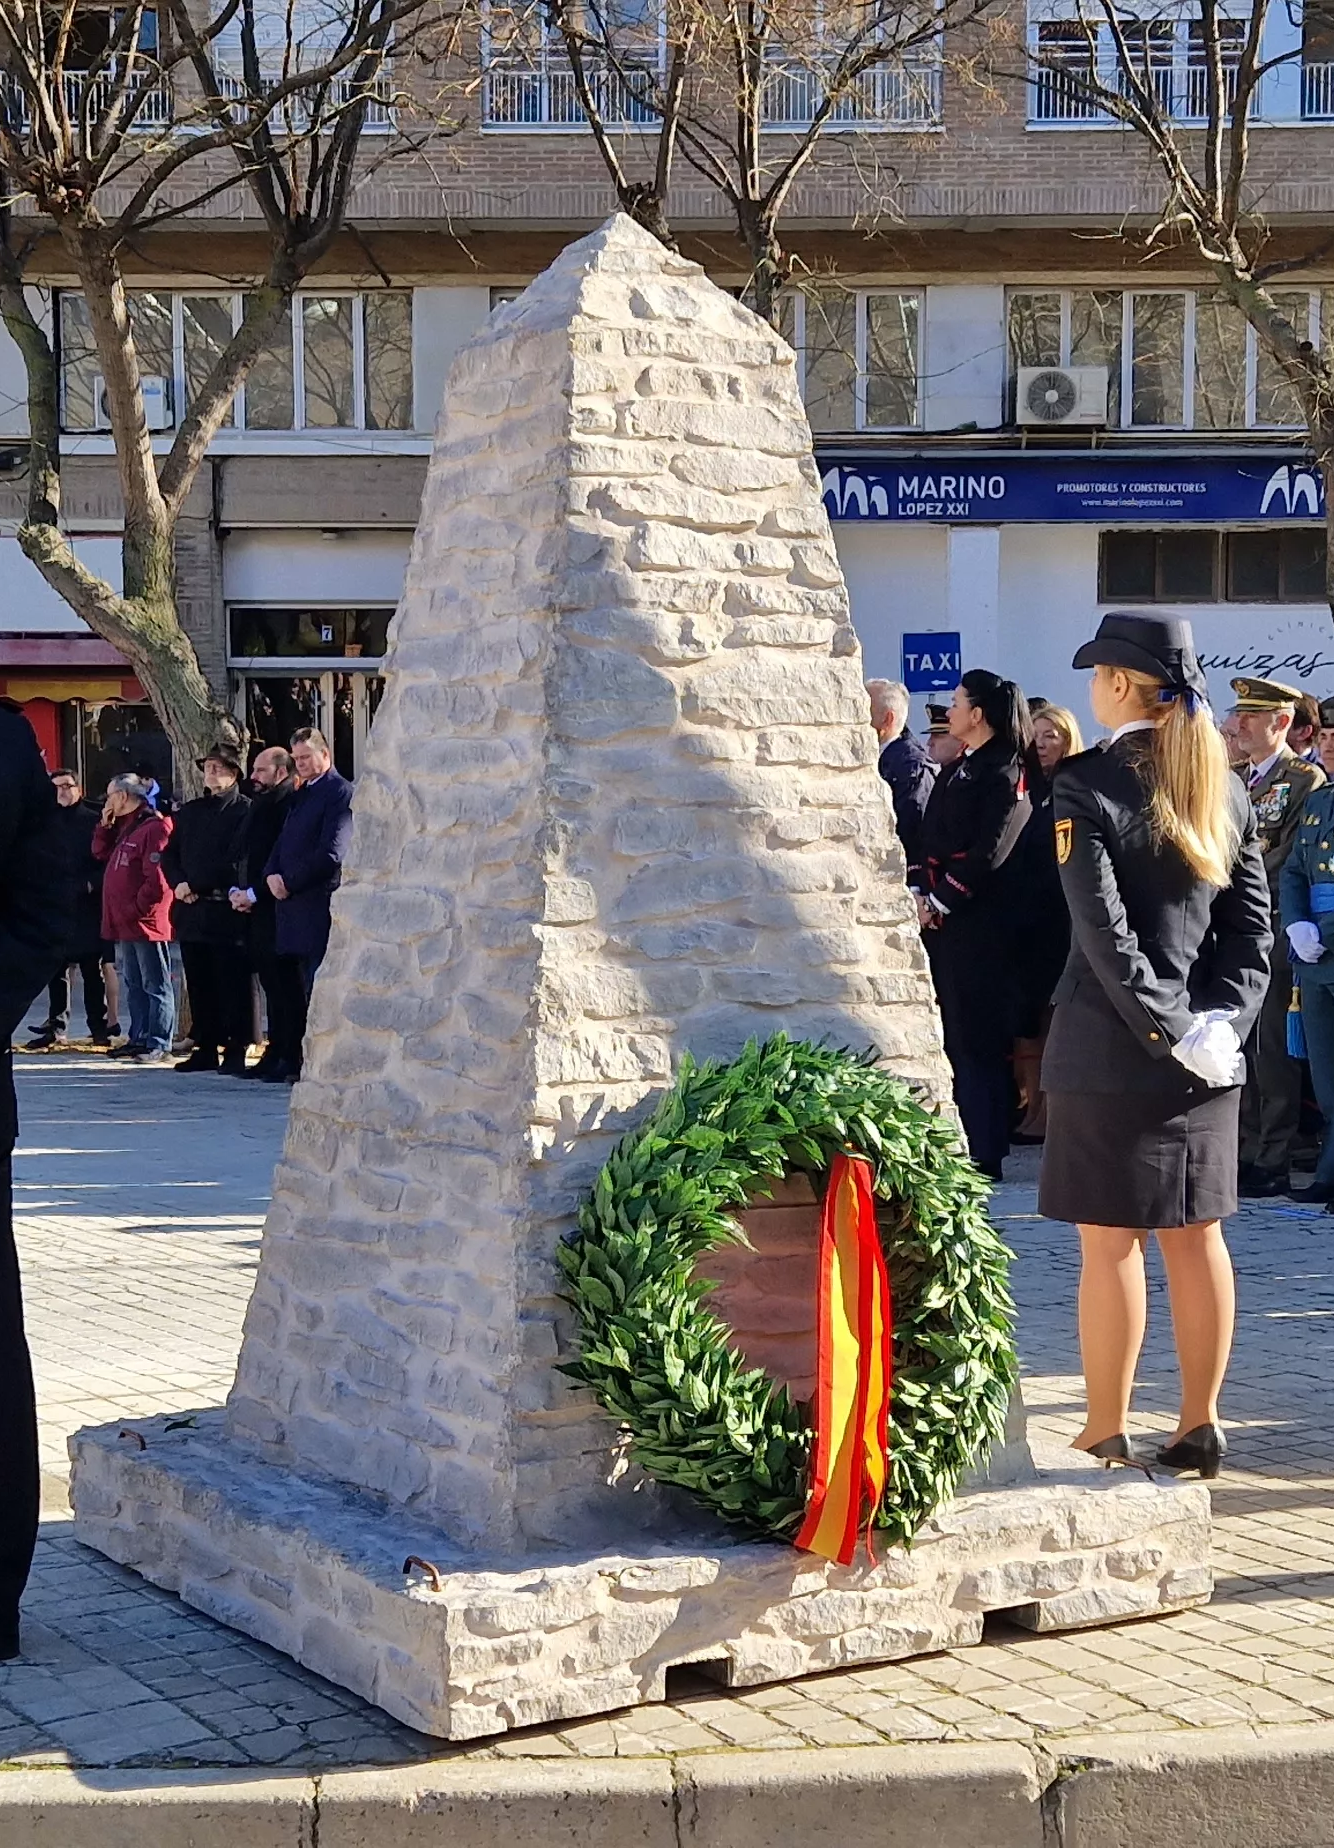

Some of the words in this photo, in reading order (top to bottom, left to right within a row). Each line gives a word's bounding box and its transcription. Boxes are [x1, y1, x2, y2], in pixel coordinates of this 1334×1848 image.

[898, 475, 1005, 499] MARINO
[1056, 483, 1118, 493] PROMOTORES
[1121, 483, 1127, 492] Y
[1129, 483, 1207, 493] CONSTRUCTORES
[898, 502, 943, 515] LOPEZ
[946, 502, 969, 515] XXI
[323, 628, 331, 640] 7
[905, 652, 960, 672] TAXI
